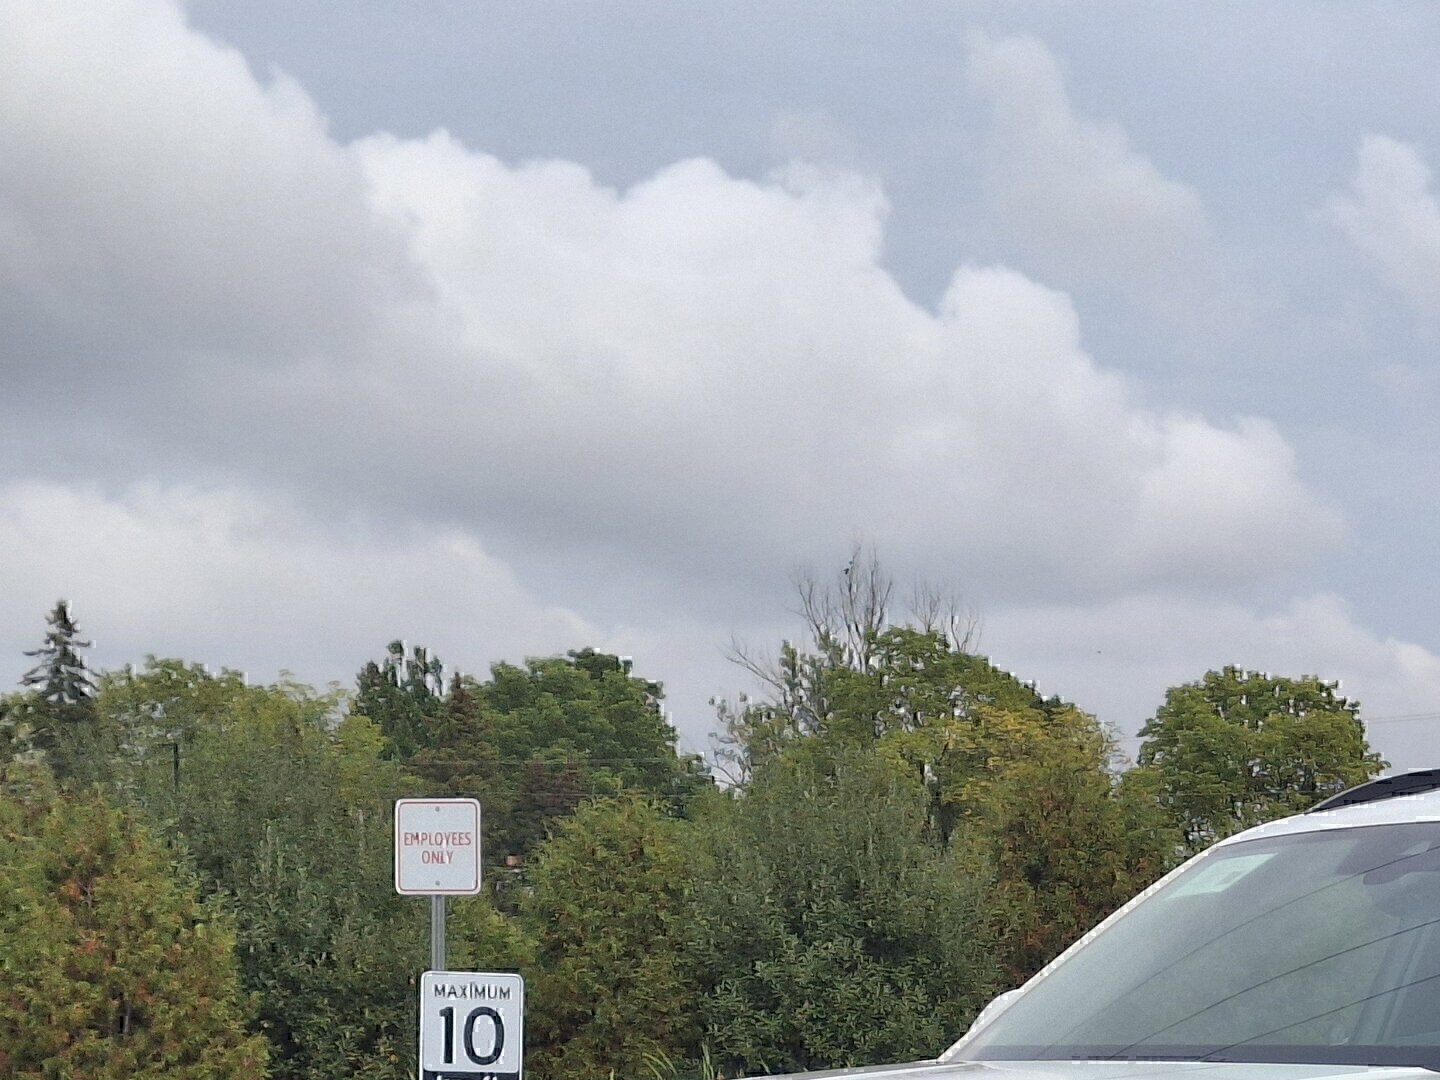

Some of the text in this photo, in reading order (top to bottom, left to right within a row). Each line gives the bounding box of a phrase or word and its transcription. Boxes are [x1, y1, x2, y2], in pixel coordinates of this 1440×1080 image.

[403, 831, 472, 847] EMPLOYEES
[421, 850, 454, 865] ONLY
[434, 982, 511, 1000] MAXIMUM
[439, 1006, 505, 1066] 10
